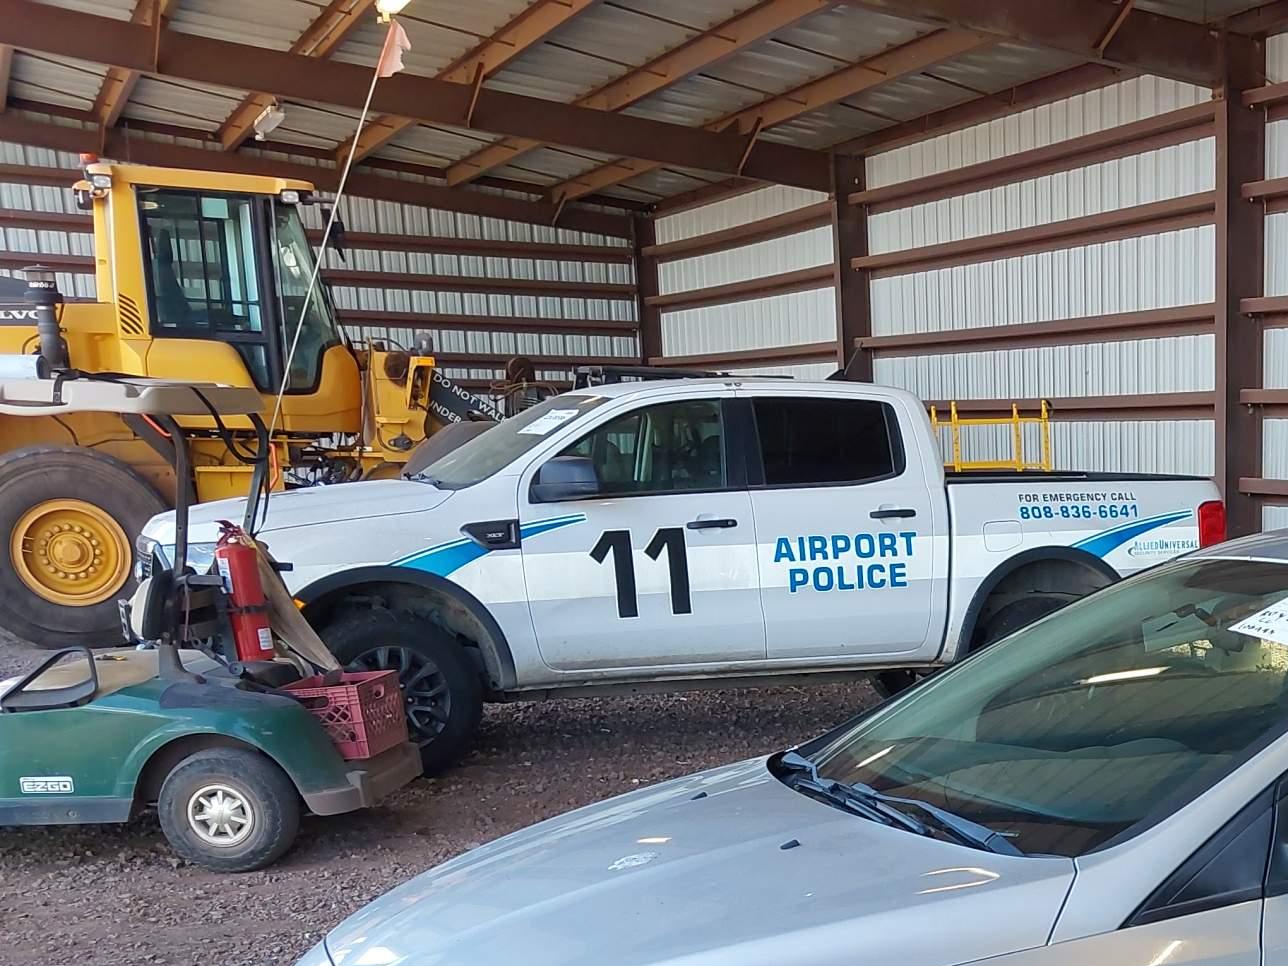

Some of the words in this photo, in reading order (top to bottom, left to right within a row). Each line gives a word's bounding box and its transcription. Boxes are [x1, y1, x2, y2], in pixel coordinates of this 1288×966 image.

[433, 373, 451, 388] DO
[451, 385, 477, 405] NOT
[1018, 493, 1040, 503] FOR
[1042, 492, 1107, 502] EMERGENCY
[1110, 492, 1137, 501] CALL
[1019, 504, 1138, 519] 808-836-6641
[773, 531, 917, 563] AIRPORT
[589, 526, 693, 619] 11
[788, 562, 908, 593] POLICE
